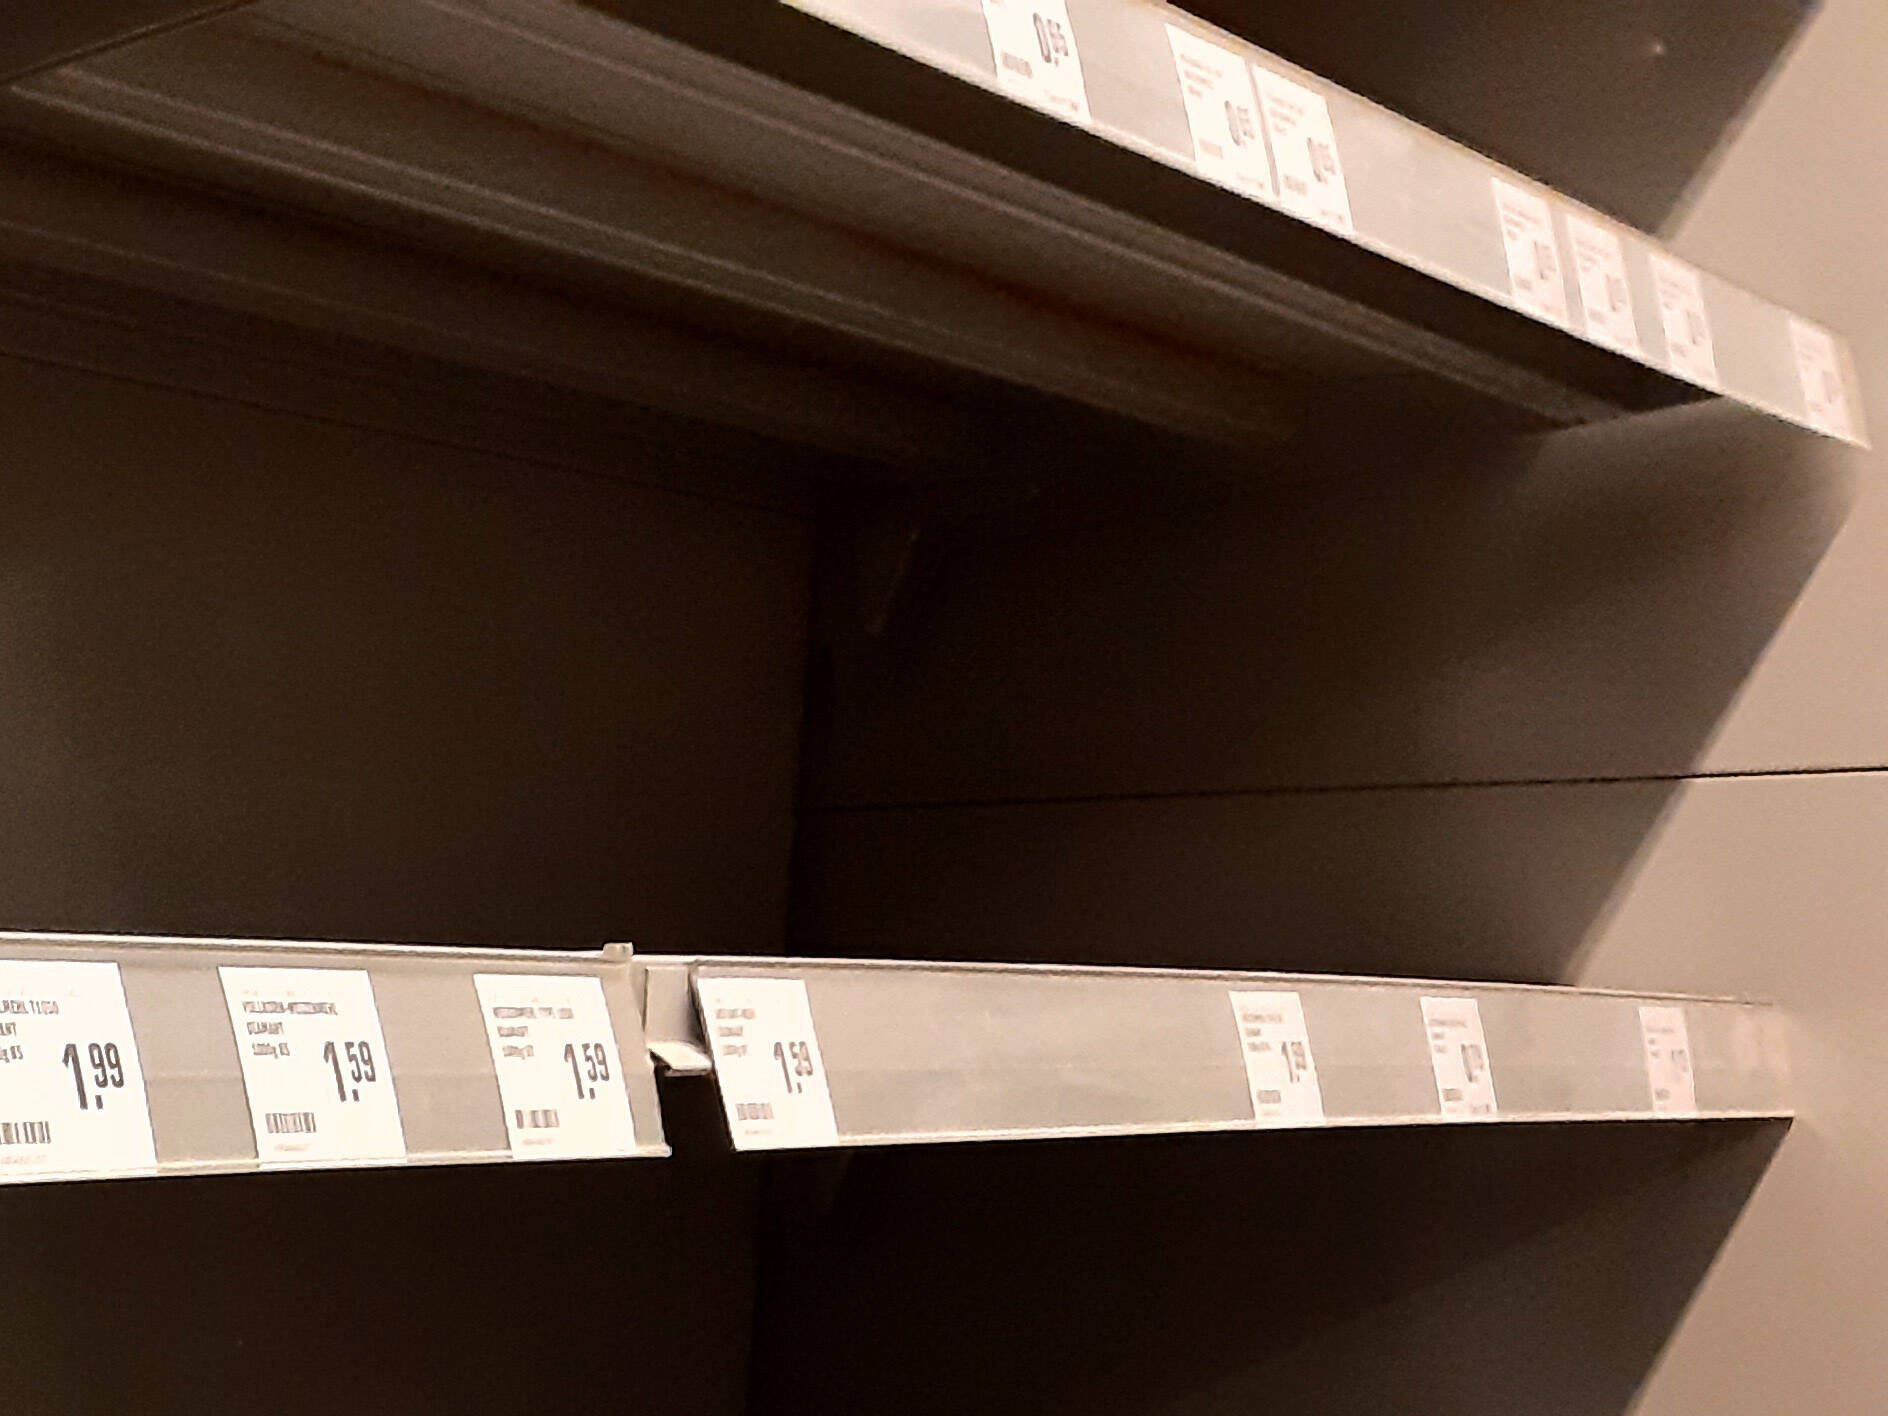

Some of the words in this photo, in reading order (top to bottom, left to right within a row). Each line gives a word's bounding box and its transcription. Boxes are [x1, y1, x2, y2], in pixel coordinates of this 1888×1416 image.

[62, 1042, 125, 1110] 1.99
[323, 1040, 377, 1102] 1.59
[564, 1043, 609, 1100] 1.59
